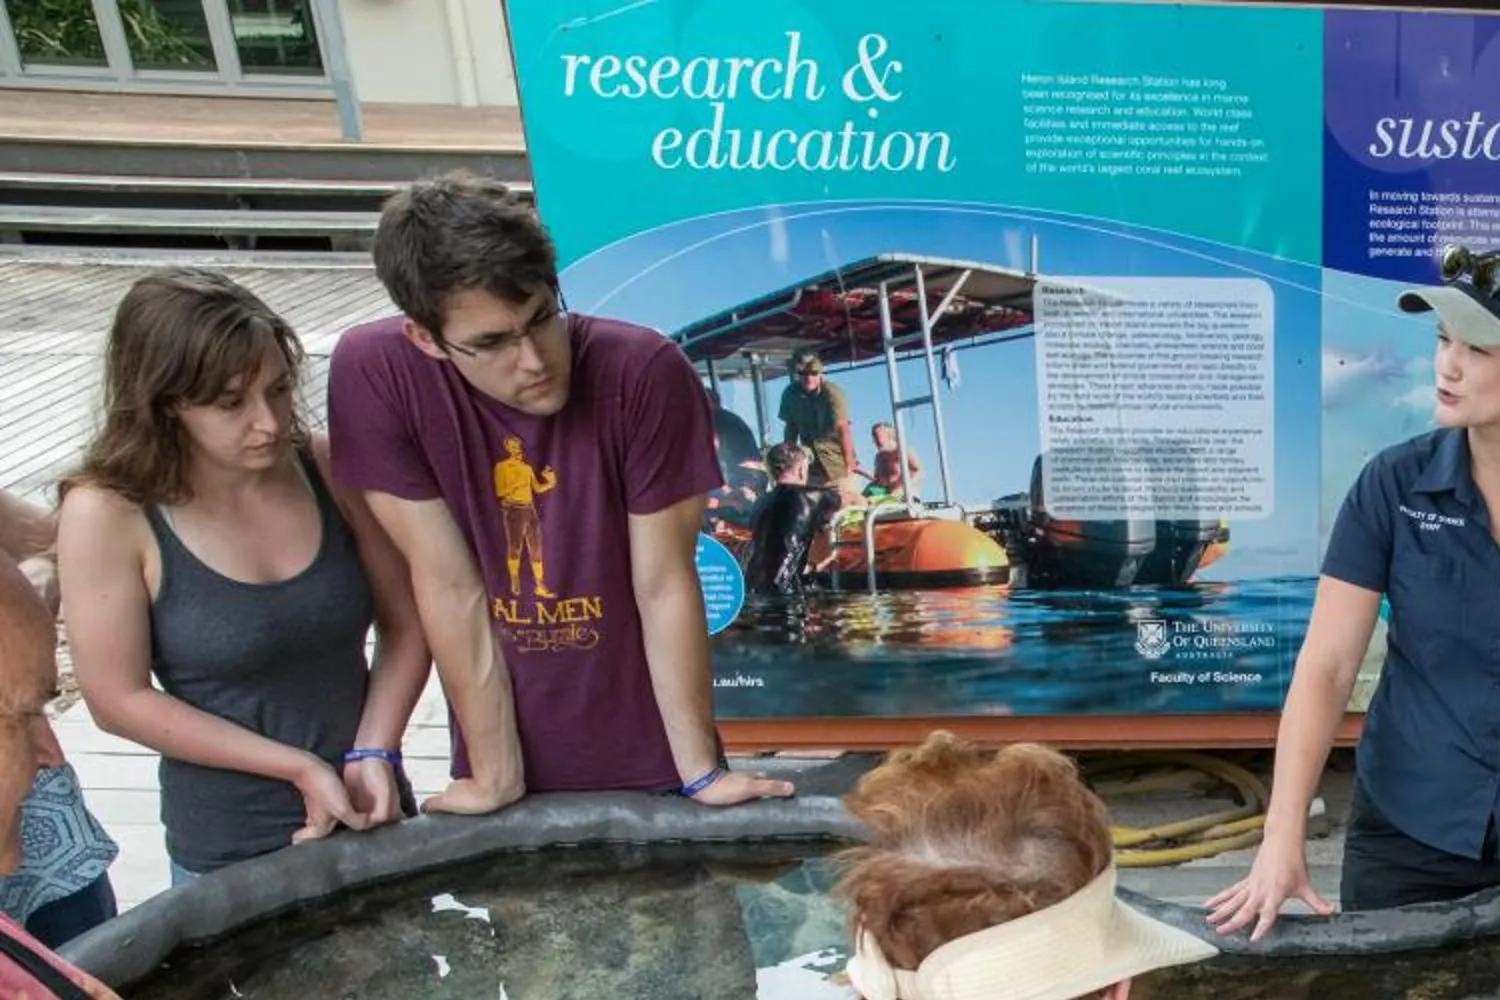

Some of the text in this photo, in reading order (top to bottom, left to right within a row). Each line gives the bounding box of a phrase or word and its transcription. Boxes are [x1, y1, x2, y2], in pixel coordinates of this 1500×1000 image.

[560, 30, 904, 103] research &
[651, 102, 958, 173] education
[1381, 191, 1419, 203] moving
[1421, 191, 1461, 203] towards
[1369, 203, 1417, 215] Research
[1419, 204, 1455, 217] Station
[1456, 205, 1465, 217] is
[1369, 218, 1420, 231] ecological
[1369, 232, 1385, 243] the
[1387, 233, 1425, 244] amount
[1427, 232, 1438, 244] of
[1369, 247, 1413, 259] generate
[1414, 246, 1433, 258] and
[494, 596, 602, 624] AL MEN
[1172, 619, 1276, 634] THE UNIVERSITY
[1172, 635, 1276, 650] OF QUEENSLAND
[713, 671, 765, 688] .au/hirs
[1149, 671, 1263, 685] Faculty of Science
